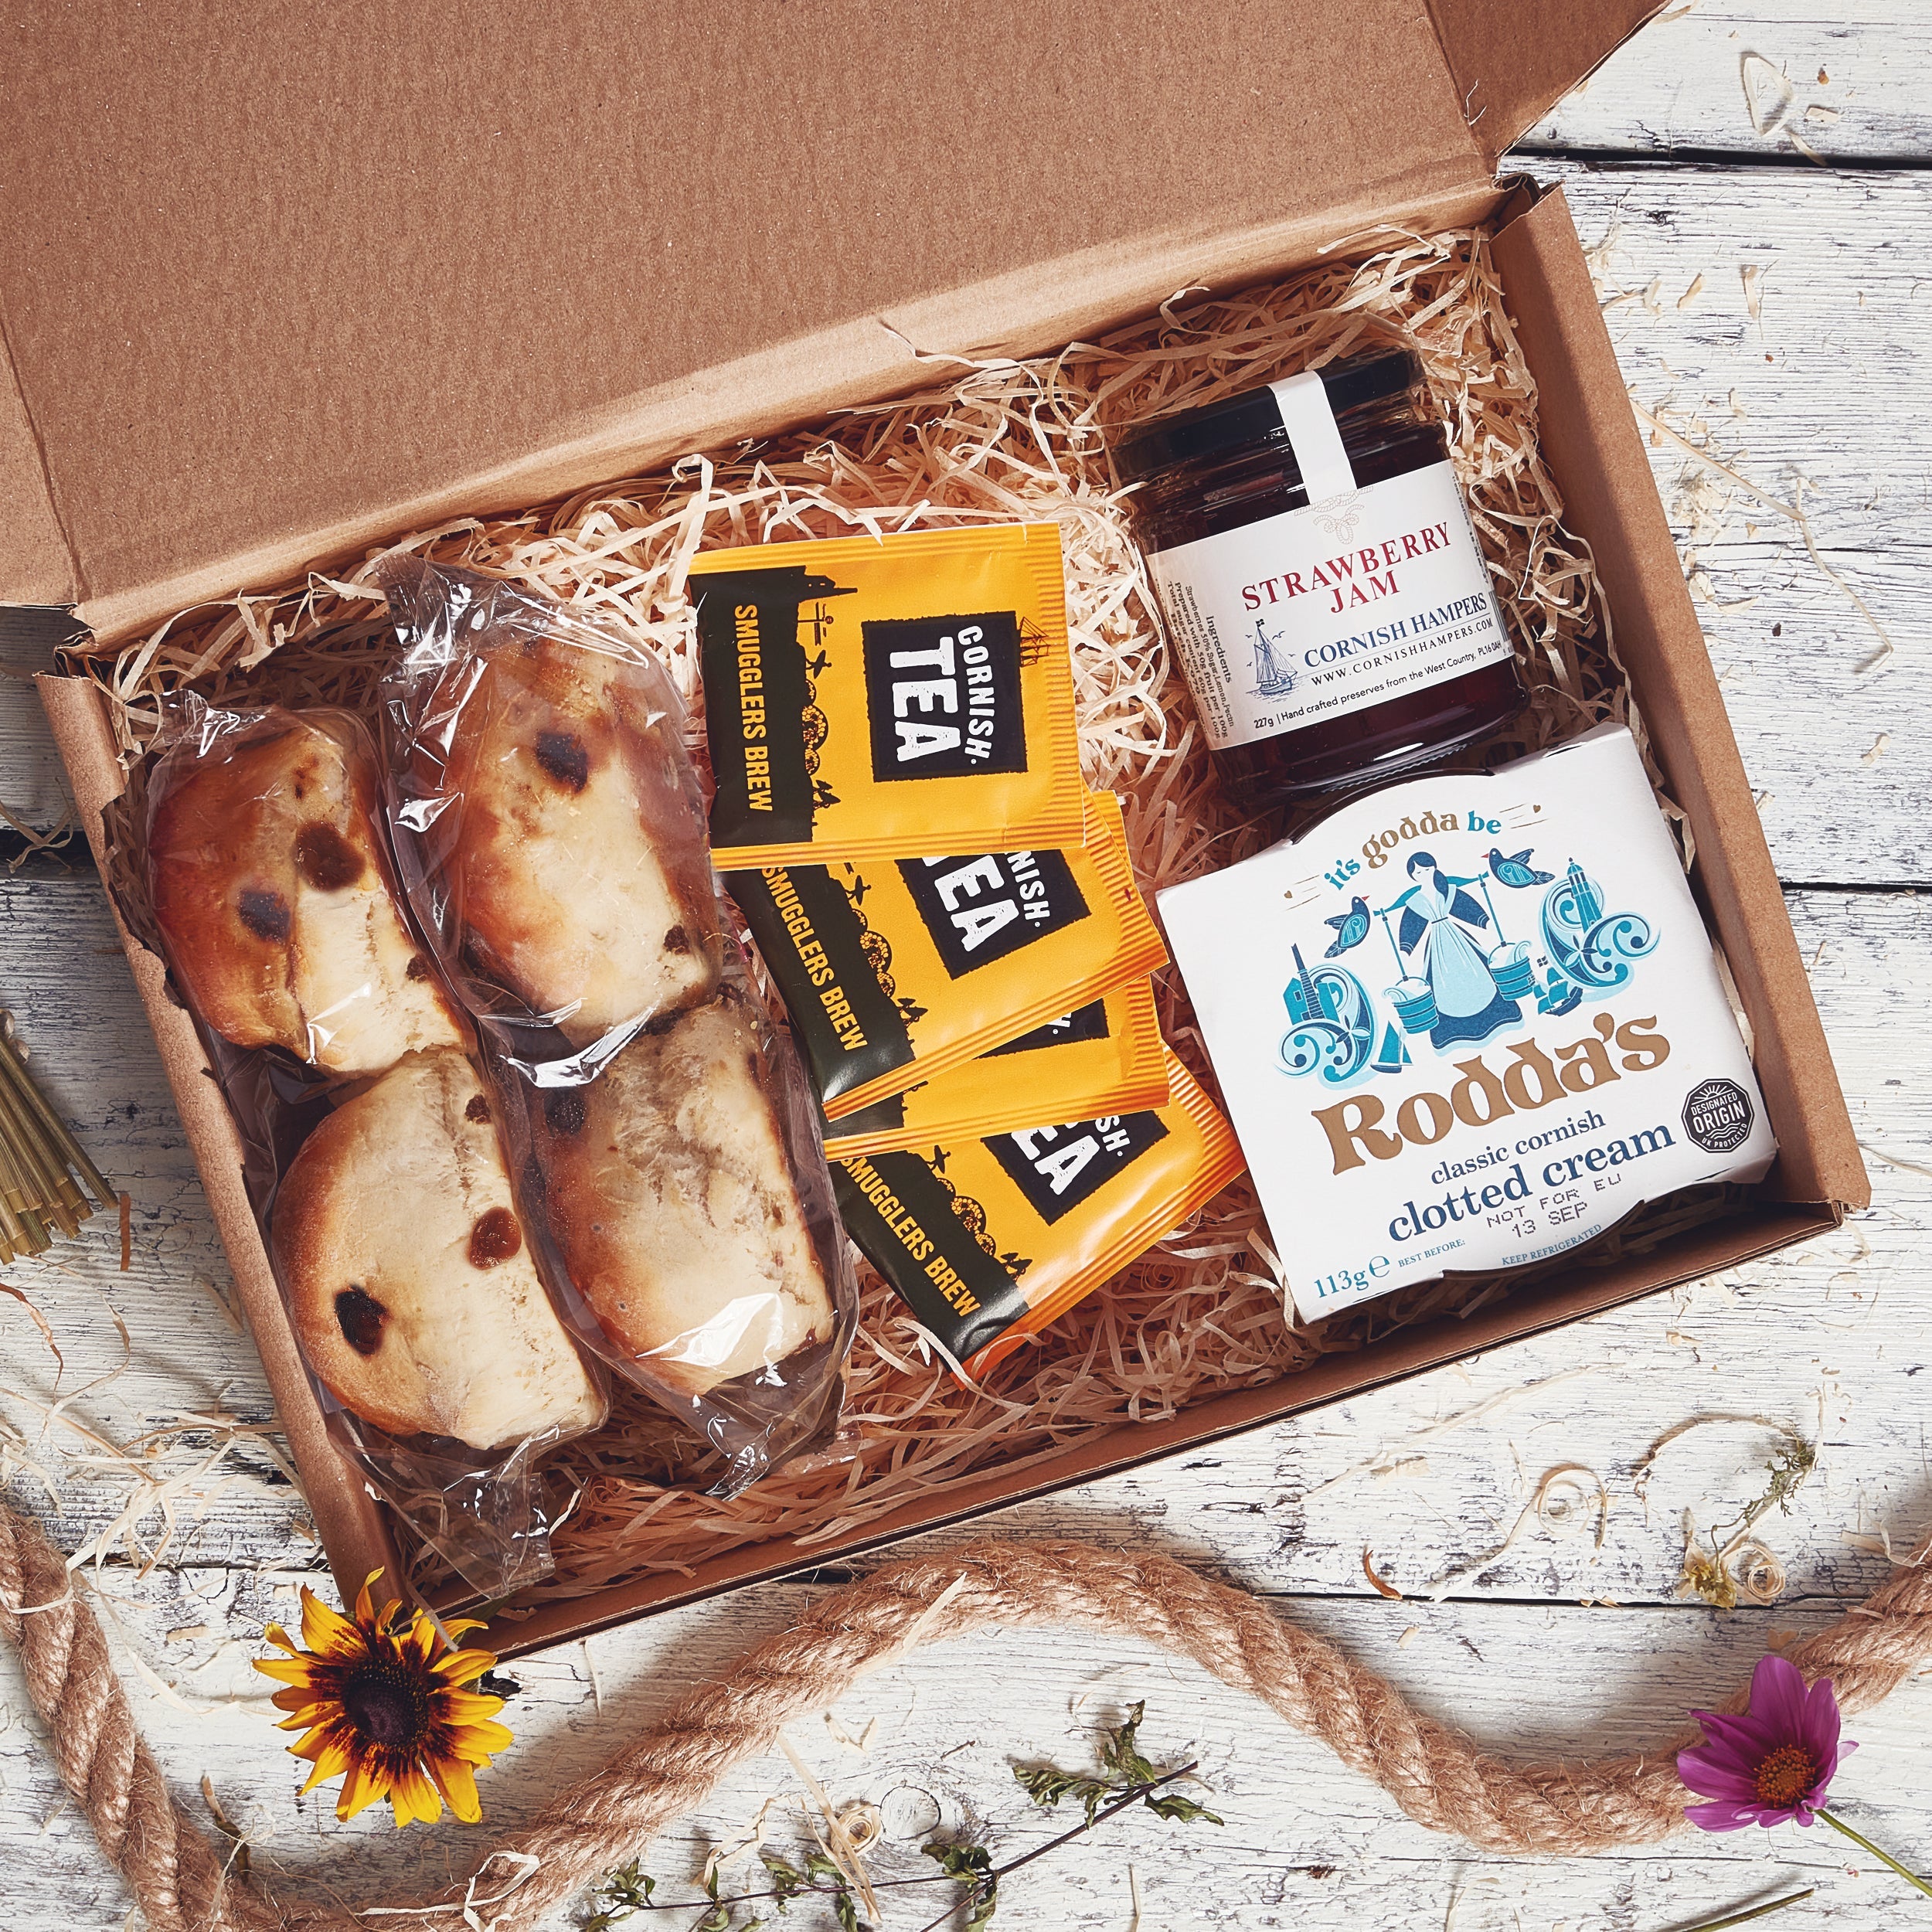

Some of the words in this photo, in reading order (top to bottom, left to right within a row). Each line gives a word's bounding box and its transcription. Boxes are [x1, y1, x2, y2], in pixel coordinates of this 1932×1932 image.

[1241, 522, 1453, 611] STRAWBERRY
[1330, 570, 1400, 614] JAM
[1167, 580, 1179, 609] Total
[1175, 609, 1188, 635] sugar
[1185, 637, 1200, 675] content
[1198, 675, 1207, 696] 60g
[1203, 696, 1213, 713] per
[1210, 715, 1221, 740] 100g
[1175, 582, 1194, 625] Prepared
[1189, 626, 1200, 649] with
[1197, 651, 1207, 670] 50g
[1204, 671, 1215, 694] fruit
[1210, 696, 1220, 712] per
[1217, 715, 1229, 739] 100g
[1200, 633, 1210, 651] 50%
[1206, 615, 1233, 684] Ingredients
[1304, 620, 1408, 668] CORNISH
[1410, 592, 1488, 634] HAMPERS
[1311, 617, 1493, 686] WWW.CORNISHHAMPERS.COM
[733, 604, 767, 741] SMUGGLERS
[889, 636, 961, 763] TEA
[957, 625, 995, 759] CORNISH
[1253, 717, 1274, 729] 227g
[1281, 706, 1304, 721] Hand
[1306, 696, 1338, 713] crafted
[1340, 683, 1385, 705] preserves
[1386, 675, 1407, 688] from
[1409, 670, 1423, 681] the
[1424, 662, 1446, 675] West
[1447, 651, 1476, 667] Country,
[1477, 645, 1492, 657] PL16
[745, 745, 773, 812] BREW
[1324, 858, 1361, 891] it's
[1362, 810, 1460, 869] godda
[1467, 810, 1502, 835] be
[921, 855, 1020, 953] EA
[1006, 851, 1051, 920] NISH
[819, 985, 868, 1052] BREW
[1311, 1012, 1671, 1175] Rodda's
[1690, 1091, 1738, 1116] DESIGNATED
[1692, 1100, 1746, 1134] ORIGIN
[1430, 1144, 1509, 1185] classic
[1515, 1110, 1606, 1158] cornish
[1701, 1137, 1713, 1147] UK
[1714, 1123, 1747, 1148] PROTECTED
[1389, 1163, 1533, 1242] clotted
[1543, 1124, 1676, 1187] cream
[1486, 1205, 1526, 1229] NOT
[1539, 1188, 1580, 1210] FOR
[1594, 1173, 1622, 1192] EU
[1398, 1253, 1422, 1267] BEST
[1423, 1238, 1466, 1259] BEFORE:
[1502, 1253, 1528, 1265] KEEP
[1530, 1224, 1602, 1260] REFRIGERATED
[1512, 1219, 1536, 1238] 13
[1548, 1201, 1587, 1226] SEP
[923, 1255, 981, 1318] BREW
[1314, 1270, 1369, 1298] 113g
